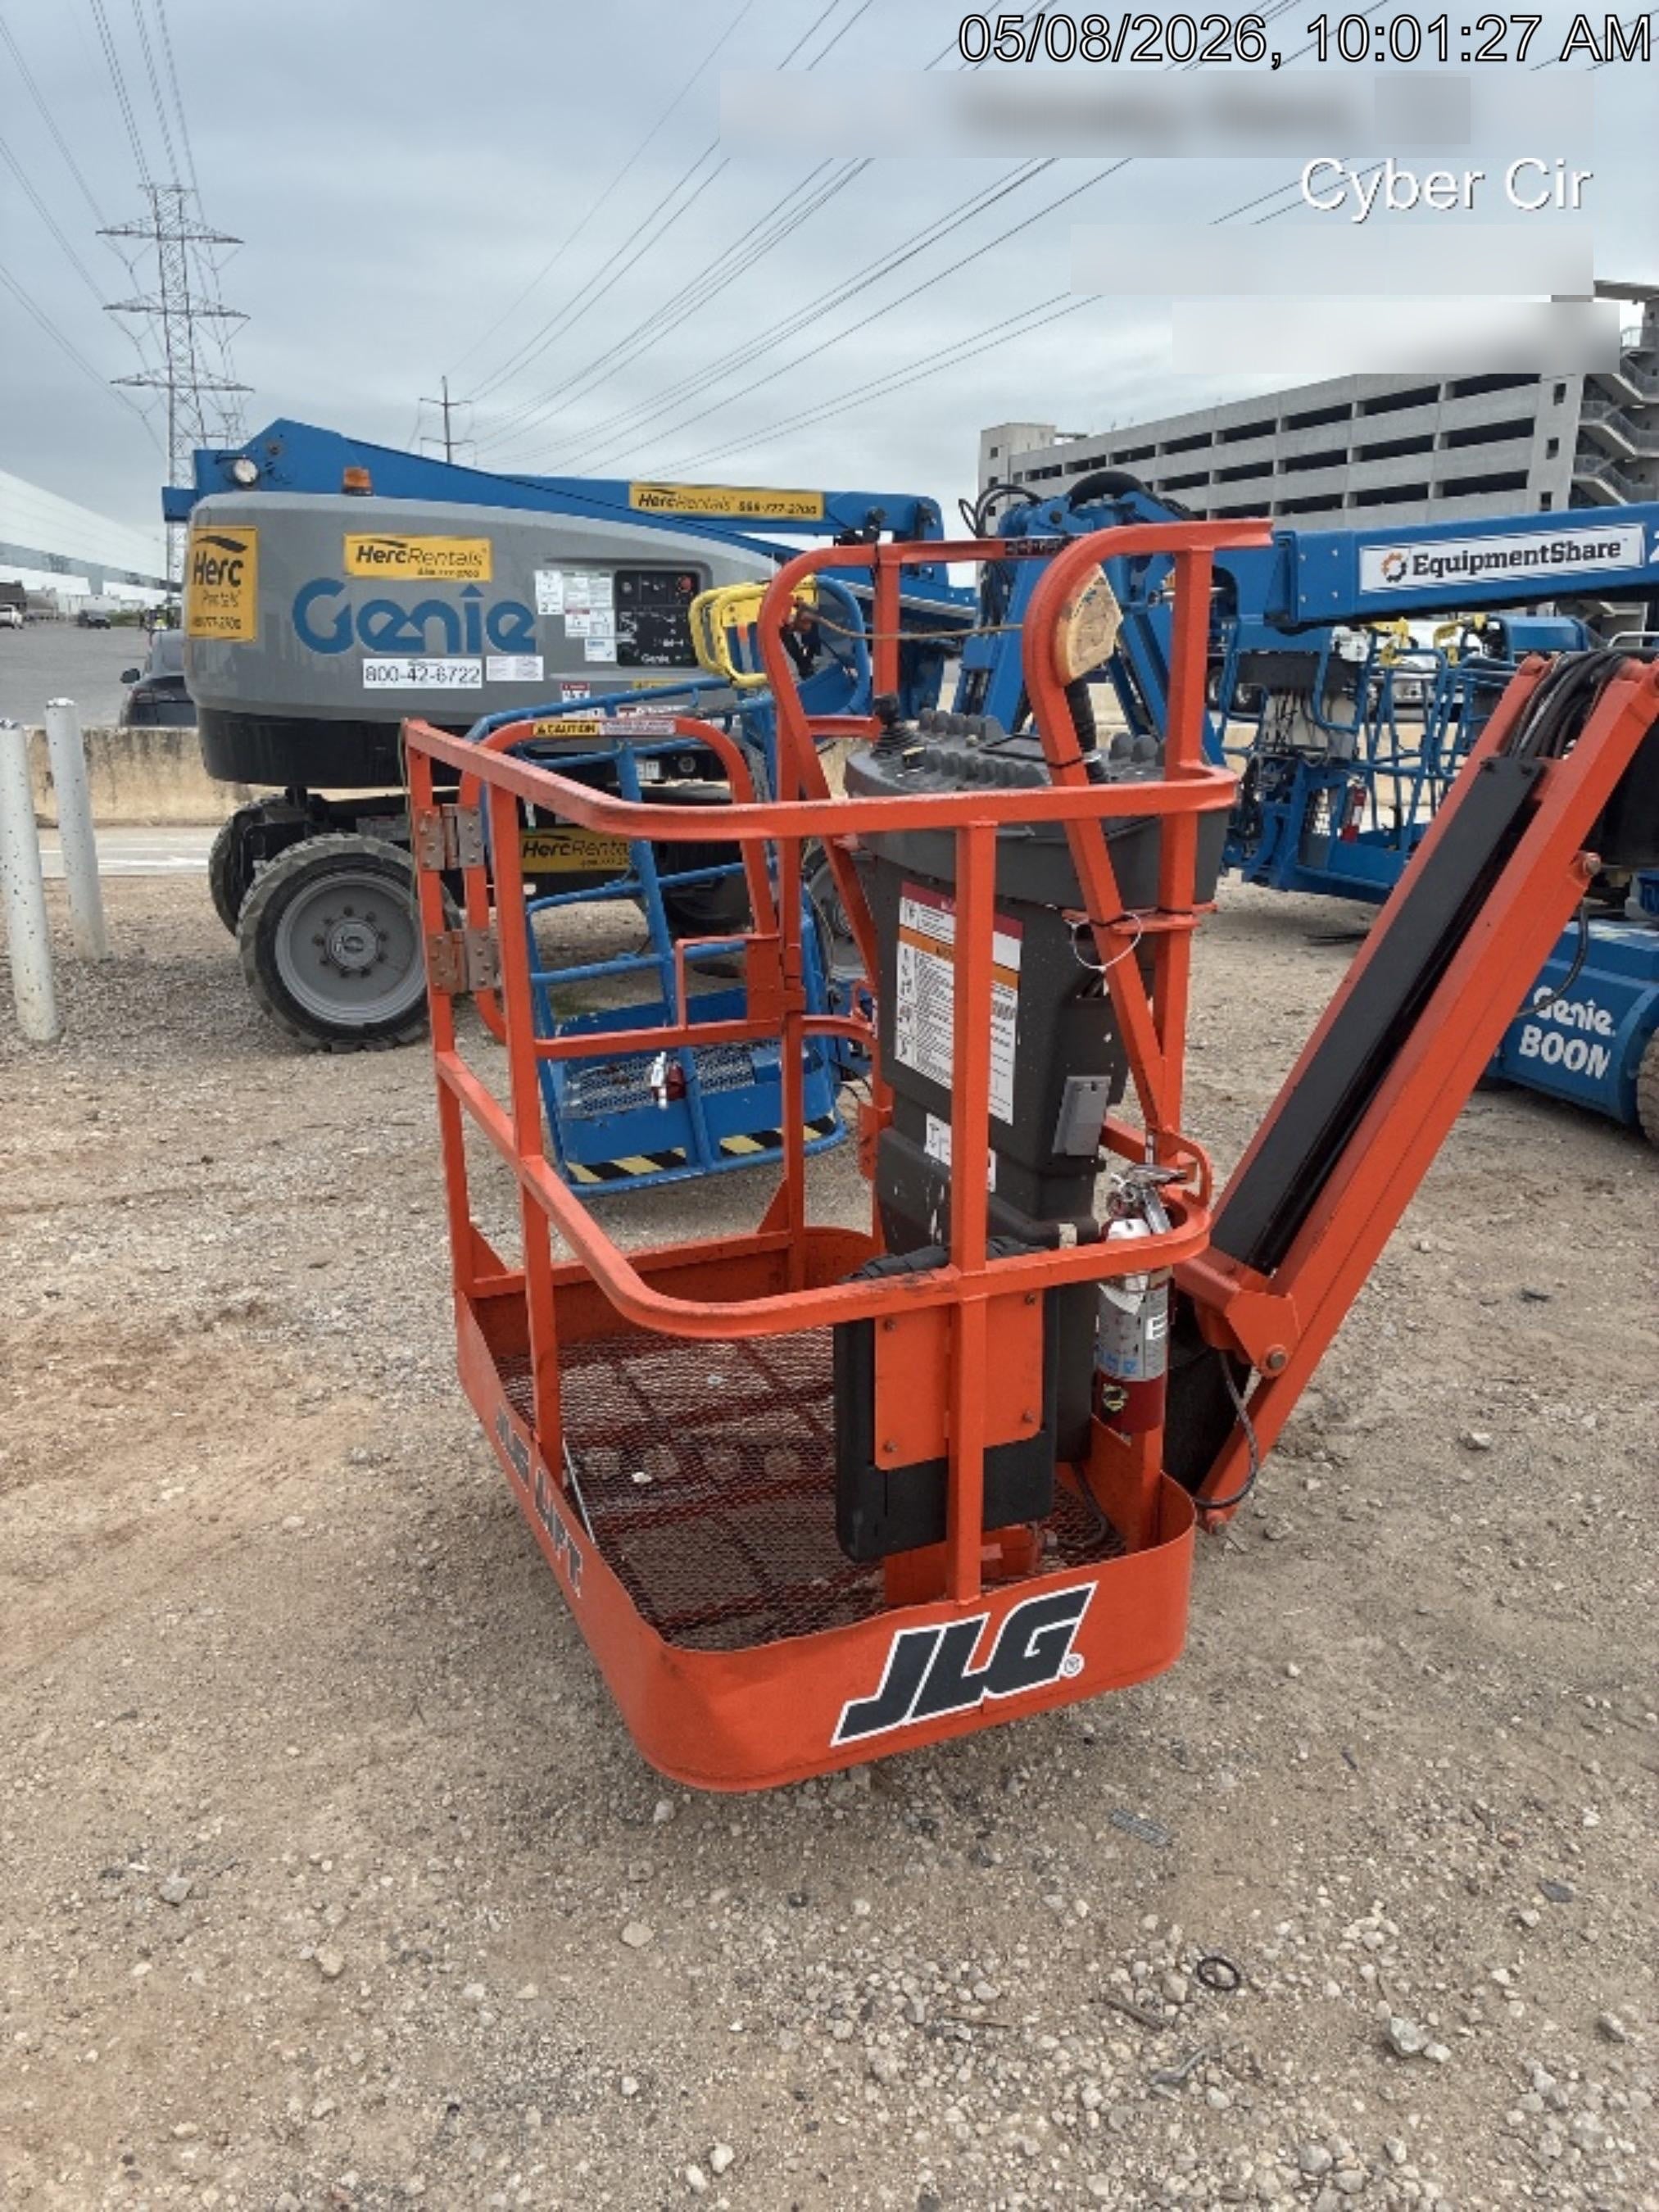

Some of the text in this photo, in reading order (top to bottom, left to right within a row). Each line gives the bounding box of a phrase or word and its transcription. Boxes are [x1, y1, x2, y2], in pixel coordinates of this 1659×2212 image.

[192, 550, 244, 588] Herc
[1412, 541, 1621, 578] EquipmentShare
[292, 577, 537, 655] Genie
[365, 664, 481, 684] 800-42-6722
